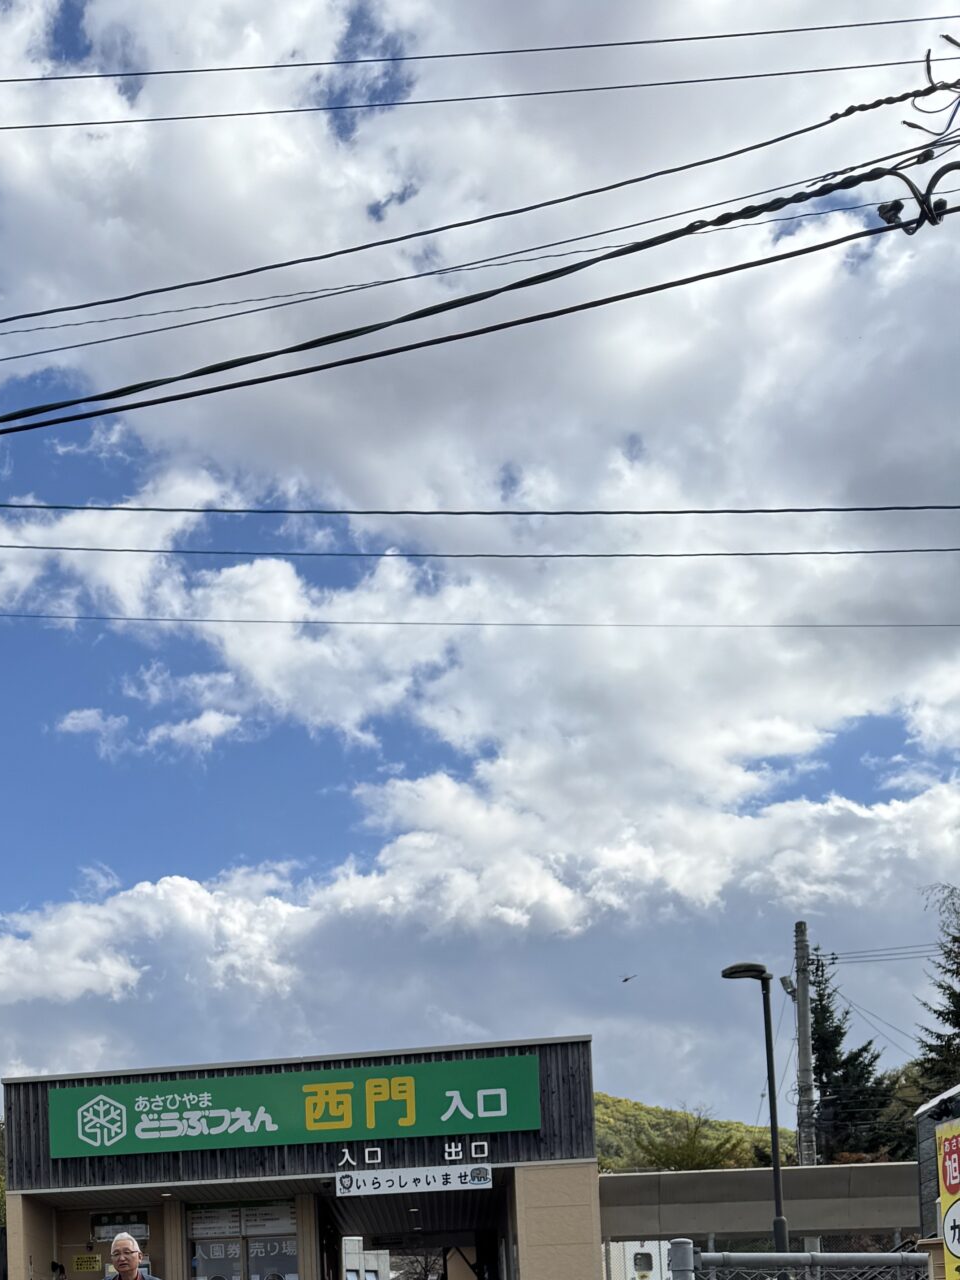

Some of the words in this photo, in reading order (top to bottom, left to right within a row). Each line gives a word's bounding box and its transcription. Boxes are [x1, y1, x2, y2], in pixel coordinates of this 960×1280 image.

[134, 1092, 212, 1112] あさひやま
[302, 1076, 416, 1131] 西門
[440, 1088, 508, 1122] 入口
[135, 1106, 278, 1139] どうぶつえん
[338, 1147, 382, 1166] 入口
[444, 1141, 488, 1160] 出口
[355, 1171, 469, 1190] いらっしゃいませ
